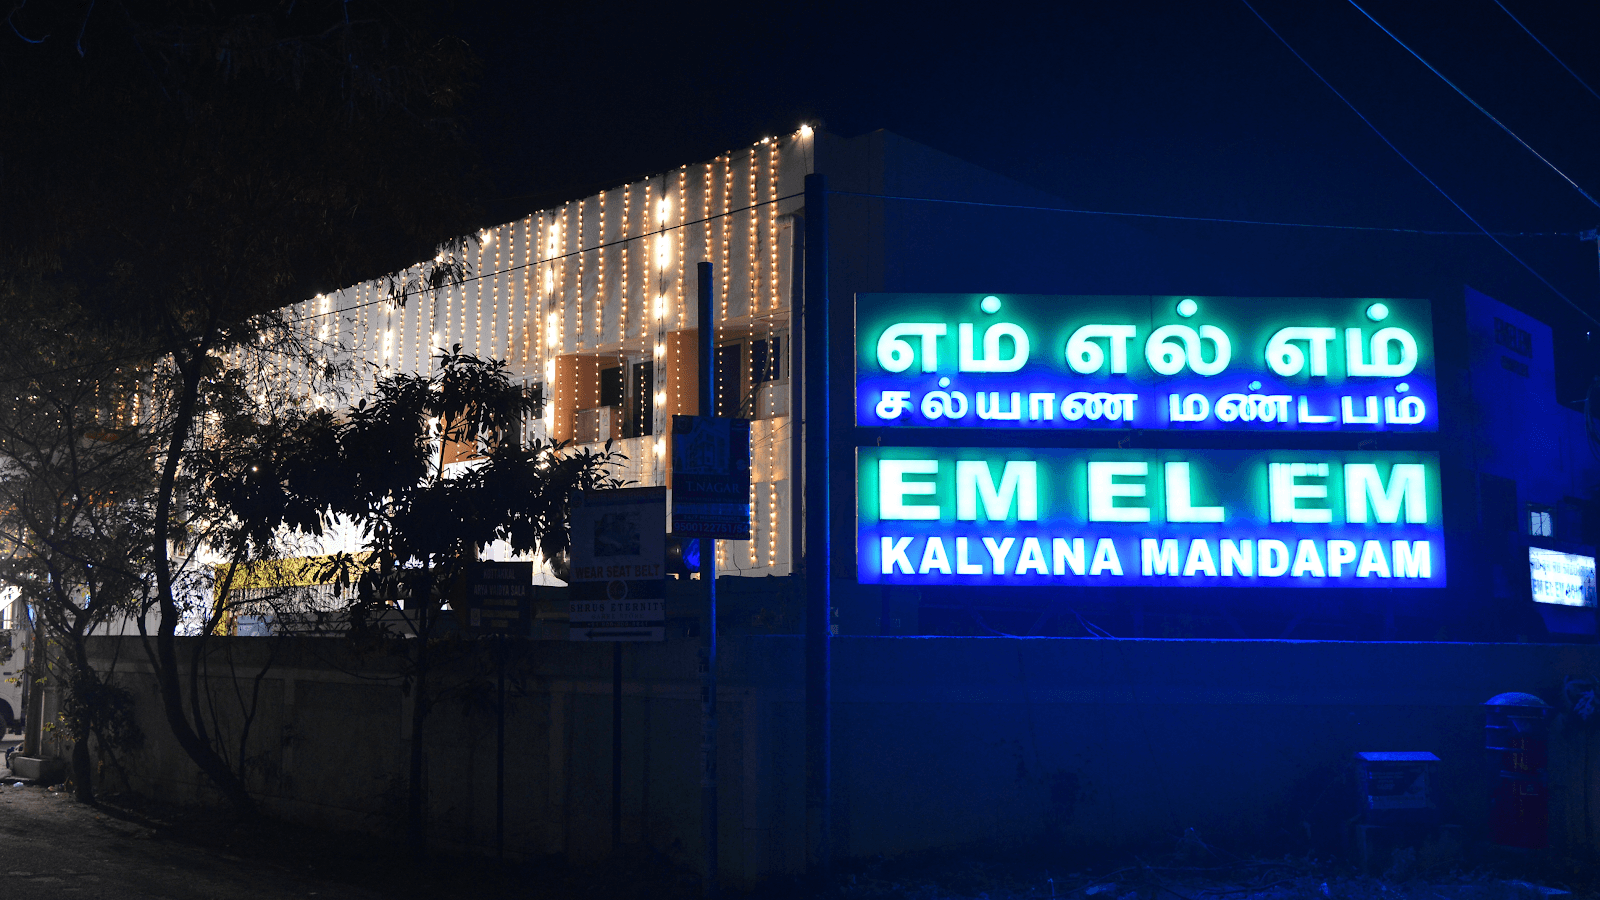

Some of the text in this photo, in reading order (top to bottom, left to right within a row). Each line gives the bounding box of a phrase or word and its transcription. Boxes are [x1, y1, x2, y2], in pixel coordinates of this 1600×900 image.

[876, 295, 1419, 378] எம் எல் எம்
[1168, 381, 1427, 425] மண்டபம்
[685, 480, 741, 494] T.NAGAR
[878, 459, 1428, 525] EM EL EM
[575, 563, 660, 579] WEAR SEAT BELT
[879, 536, 1432, 580] KALYANA MANDAPAM
[570, 602, 665, 612] SHRUS ETERNITY
